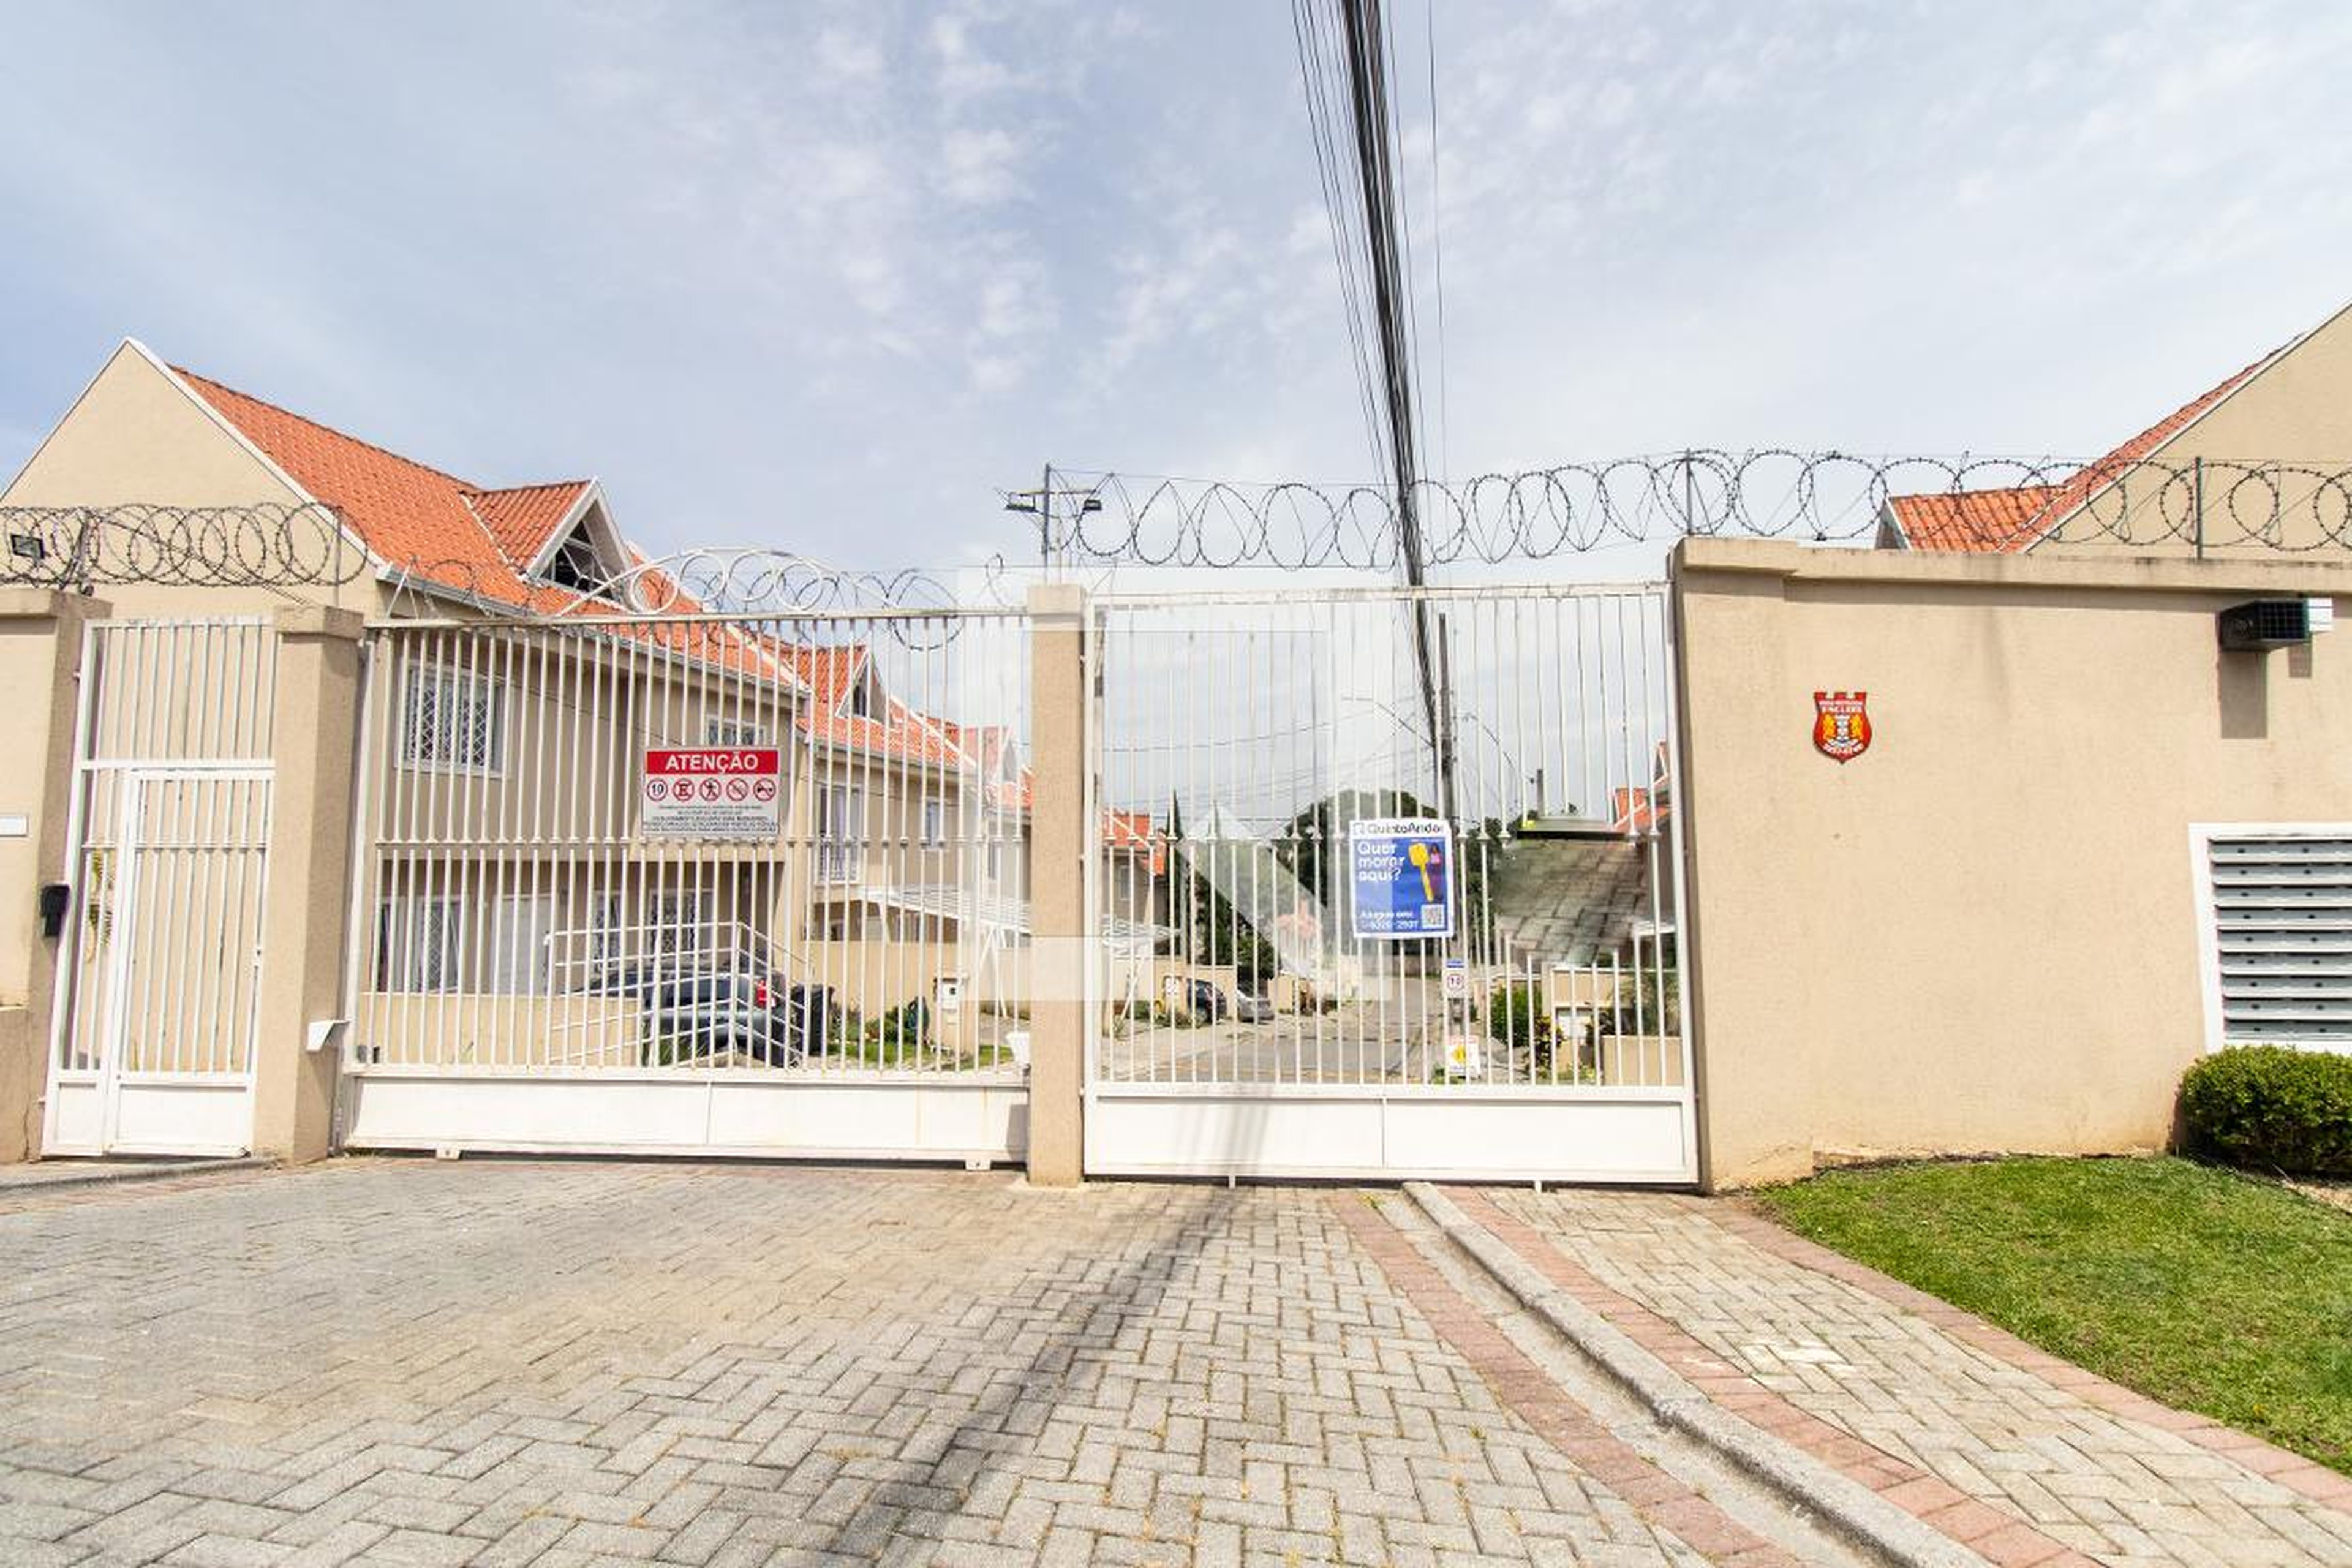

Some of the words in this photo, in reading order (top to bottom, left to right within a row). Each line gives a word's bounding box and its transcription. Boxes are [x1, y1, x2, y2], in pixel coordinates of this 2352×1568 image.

[665, 751, 759, 773] ATENÇÃO
[652, 783, 664, 795] 10
[1357, 842, 1397, 855] Quer
[1358, 857, 1406, 869] morar
[1359, 867, 1401, 882] aqui?
